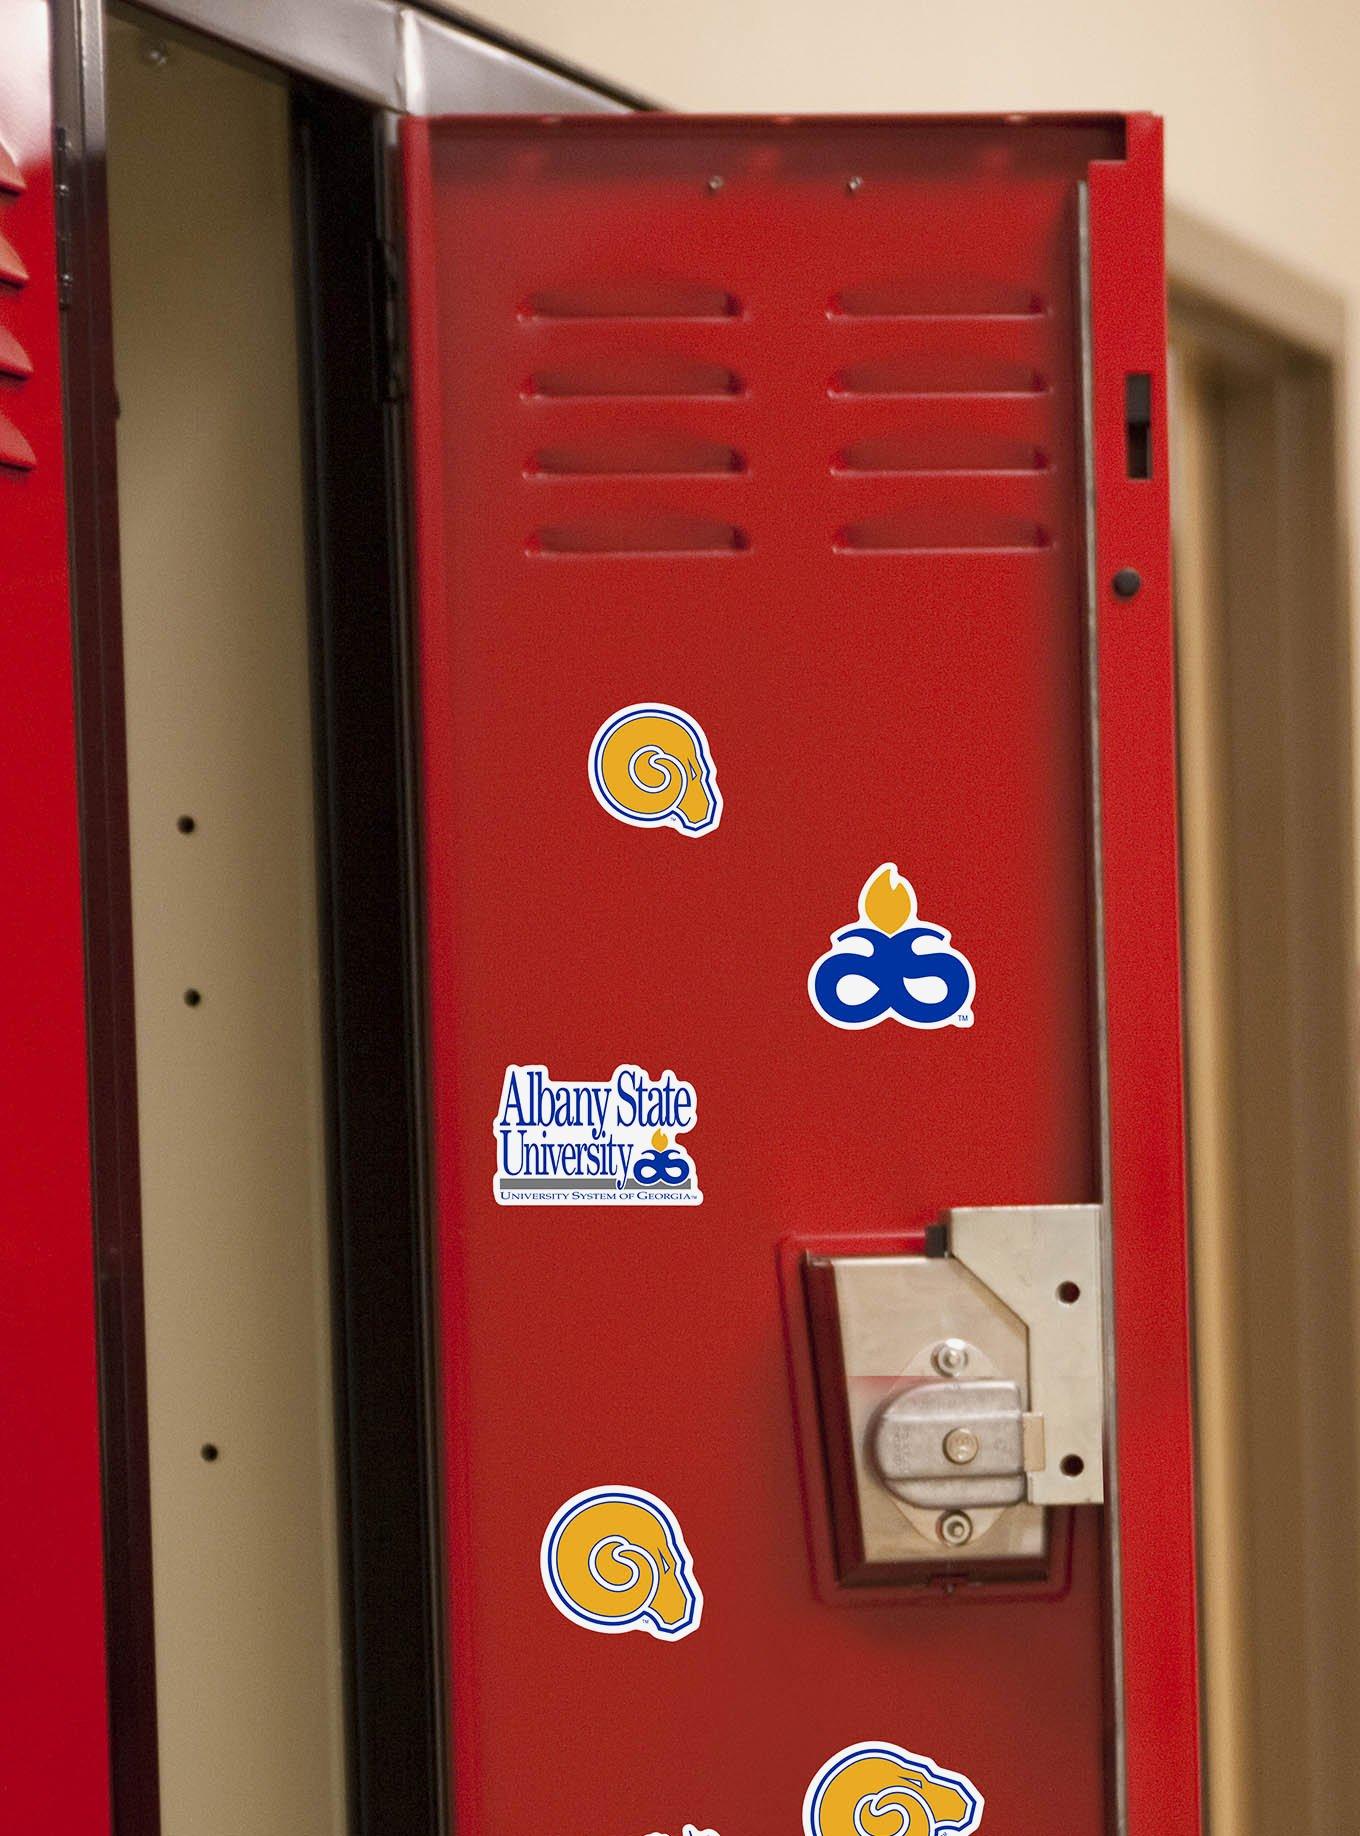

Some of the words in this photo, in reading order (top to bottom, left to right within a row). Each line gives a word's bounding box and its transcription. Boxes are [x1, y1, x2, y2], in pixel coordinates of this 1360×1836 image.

[499, 1069, 612, 1141] Albany
[616, 1069, 692, 1128] State
[499, 1129, 634, 1190] University
